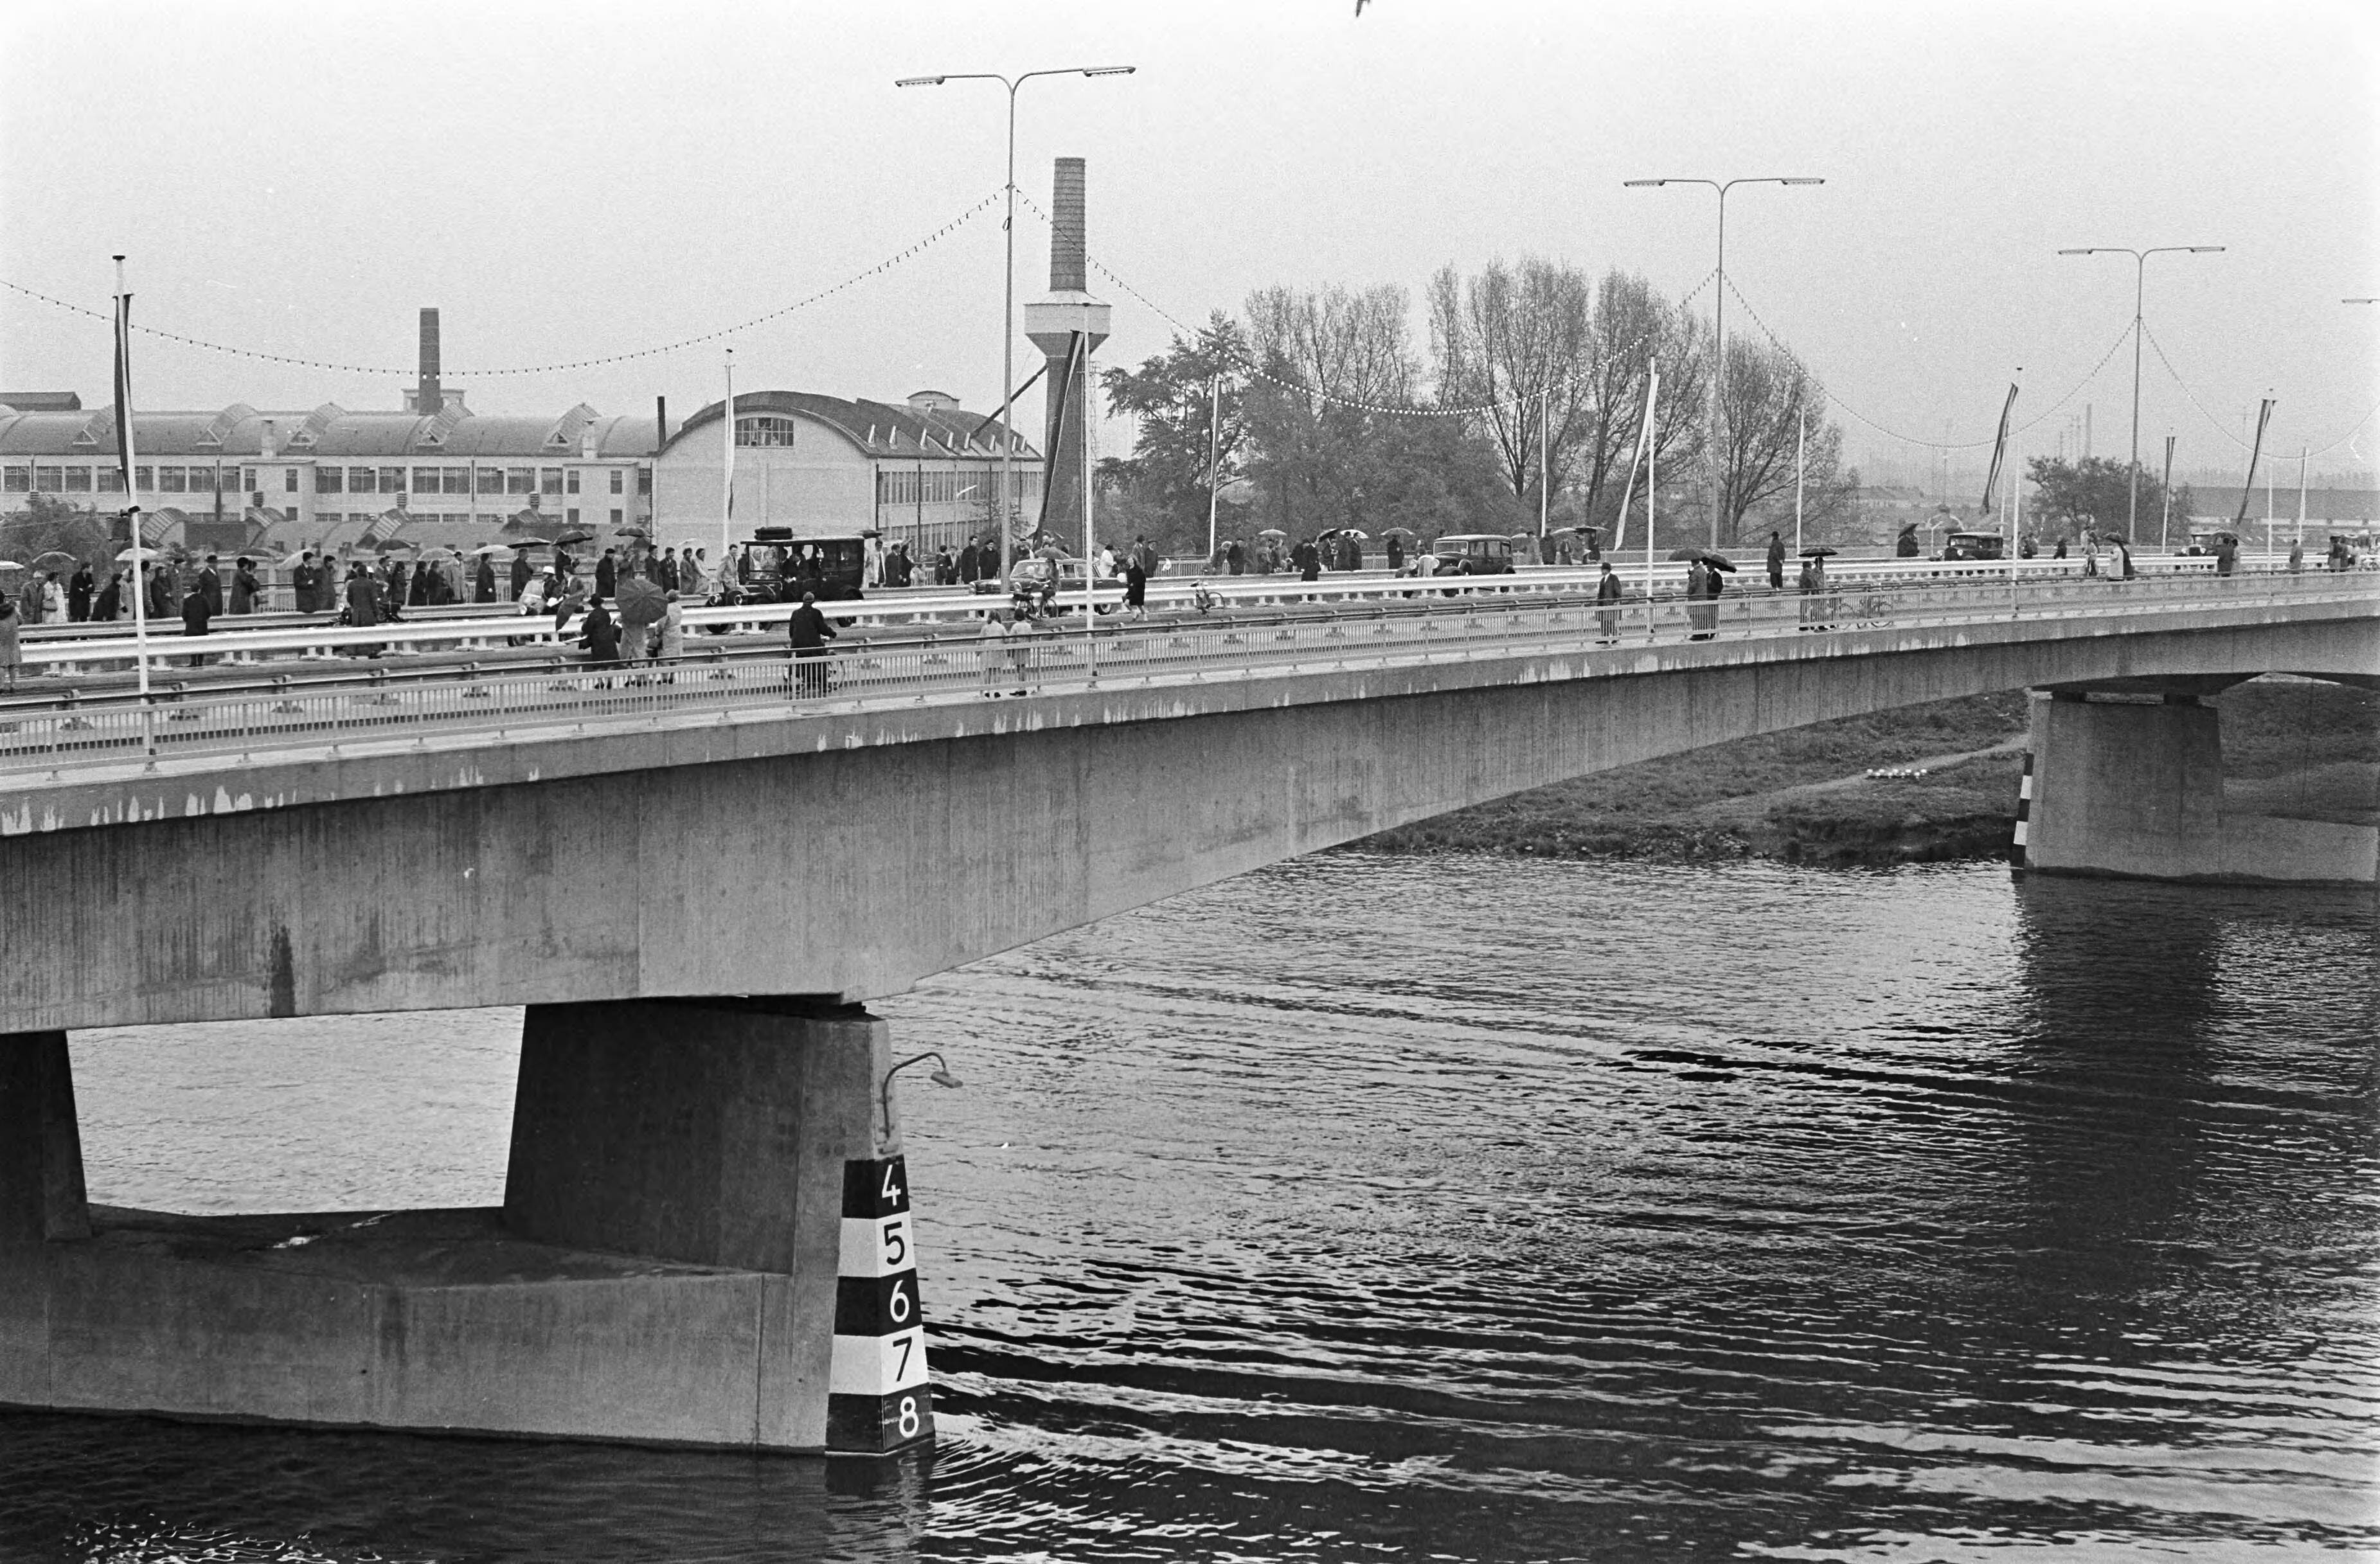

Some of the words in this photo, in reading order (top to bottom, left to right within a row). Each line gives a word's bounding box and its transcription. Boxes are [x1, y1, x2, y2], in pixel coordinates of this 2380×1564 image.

[882, 1164, 901, 1206] 4
[884, 1222, 905, 1265] 5
[890, 1280, 909, 1322] 6
[893, 1337, 912, 1382] 7
[899, 1396, 919, 1438] 8
